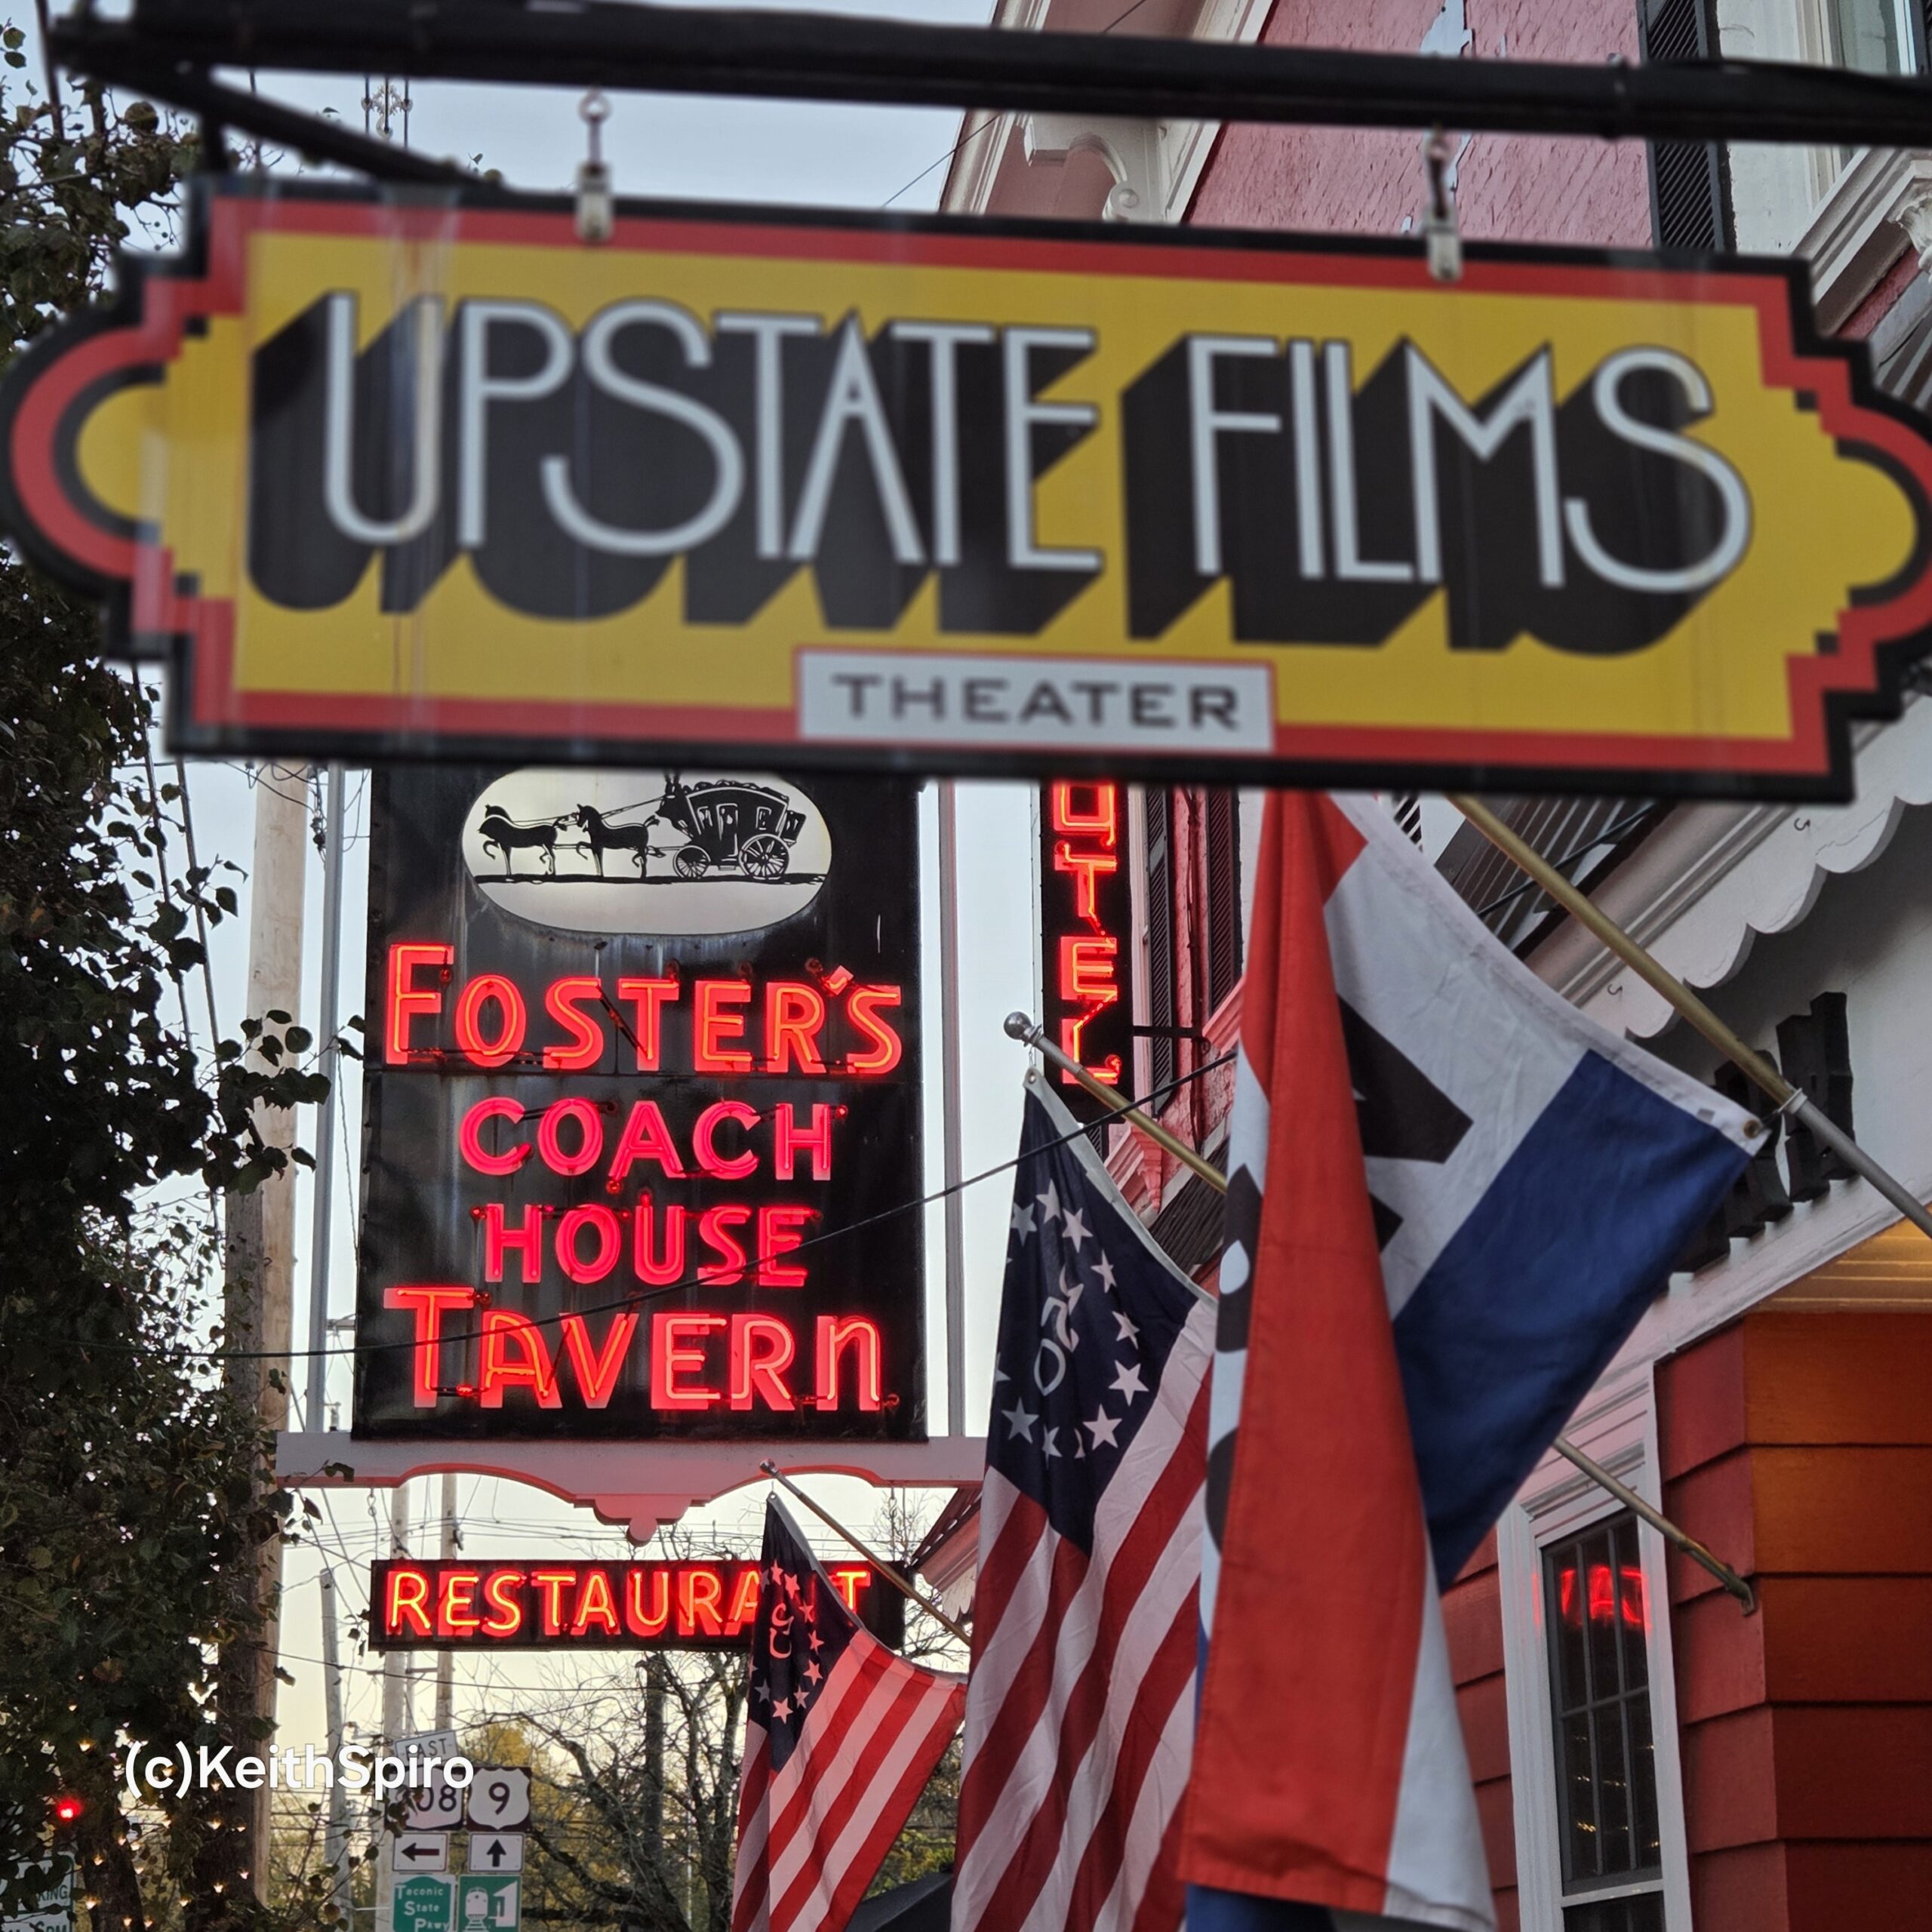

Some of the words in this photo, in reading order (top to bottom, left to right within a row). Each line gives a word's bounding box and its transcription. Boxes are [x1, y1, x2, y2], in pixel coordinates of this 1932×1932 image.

[325, 291, 1105, 570] UPSTATE
[1186, 334, 1753, 594] FILMS
[832, 674, 1240, 731] THEATER
[386, 943, 903, 1075] FOSTER'S
[459, 1097, 832, 1181] COACH
[485, 1203, 809, 1287] HOUSE
[386, 1568, 872, 1638] RESTAURAT
[400, 1782, 457, 1813] 08
[488, 1782, 510, 1815] 9
[395, 1884, 444, 1900] Taconic
[403, 1900, 441, 1916] State
[414, 1918, 450, 1932] Pkwy
